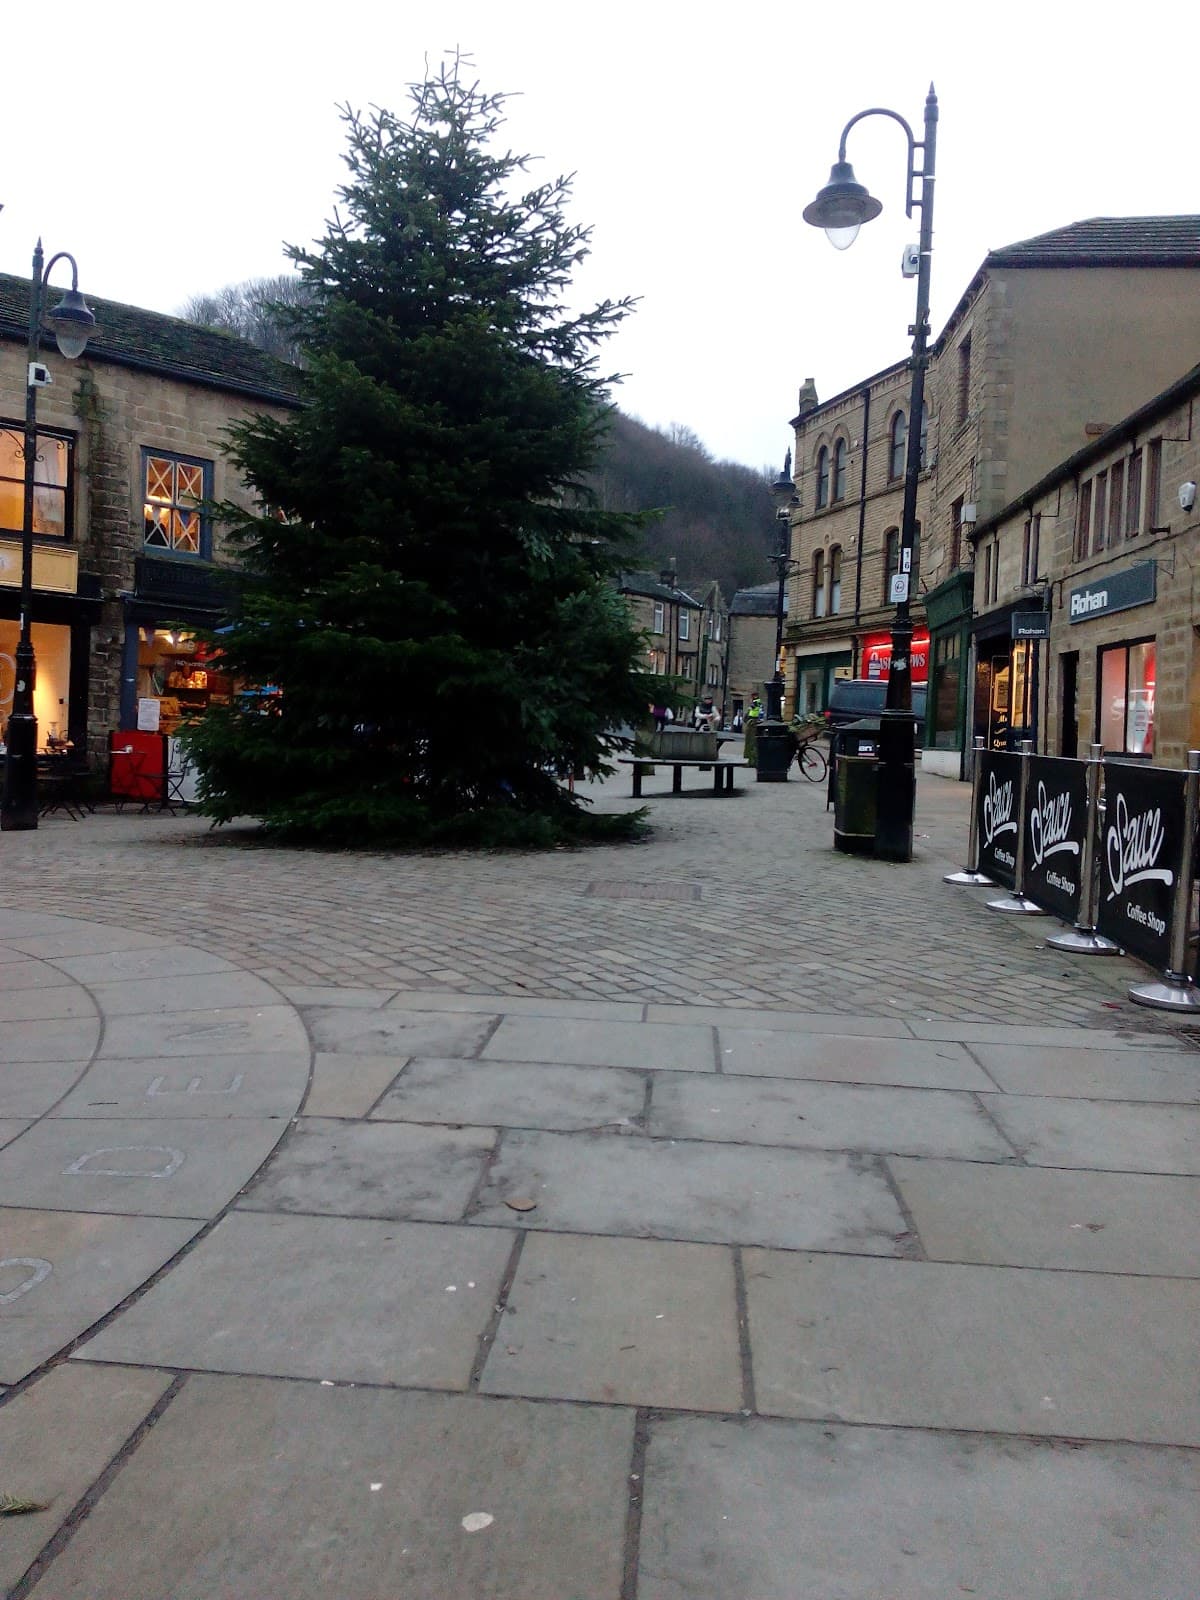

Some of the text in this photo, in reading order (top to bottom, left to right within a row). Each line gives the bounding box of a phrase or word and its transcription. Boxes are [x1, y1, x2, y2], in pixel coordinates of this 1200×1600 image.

[1071, 590, 1108, 616] Rohan
[984, 771, 1014, 848] Sauce
[1030, 780, 1073, 871] Sauce
[994, 847, 1015, 867] Coffee Shop
[1107, 793, 1165, 902] Sauce
[1046, 870, 1075, 896] Coffee Shop
[1127, 902, 1166, 936] Coffee Shop
